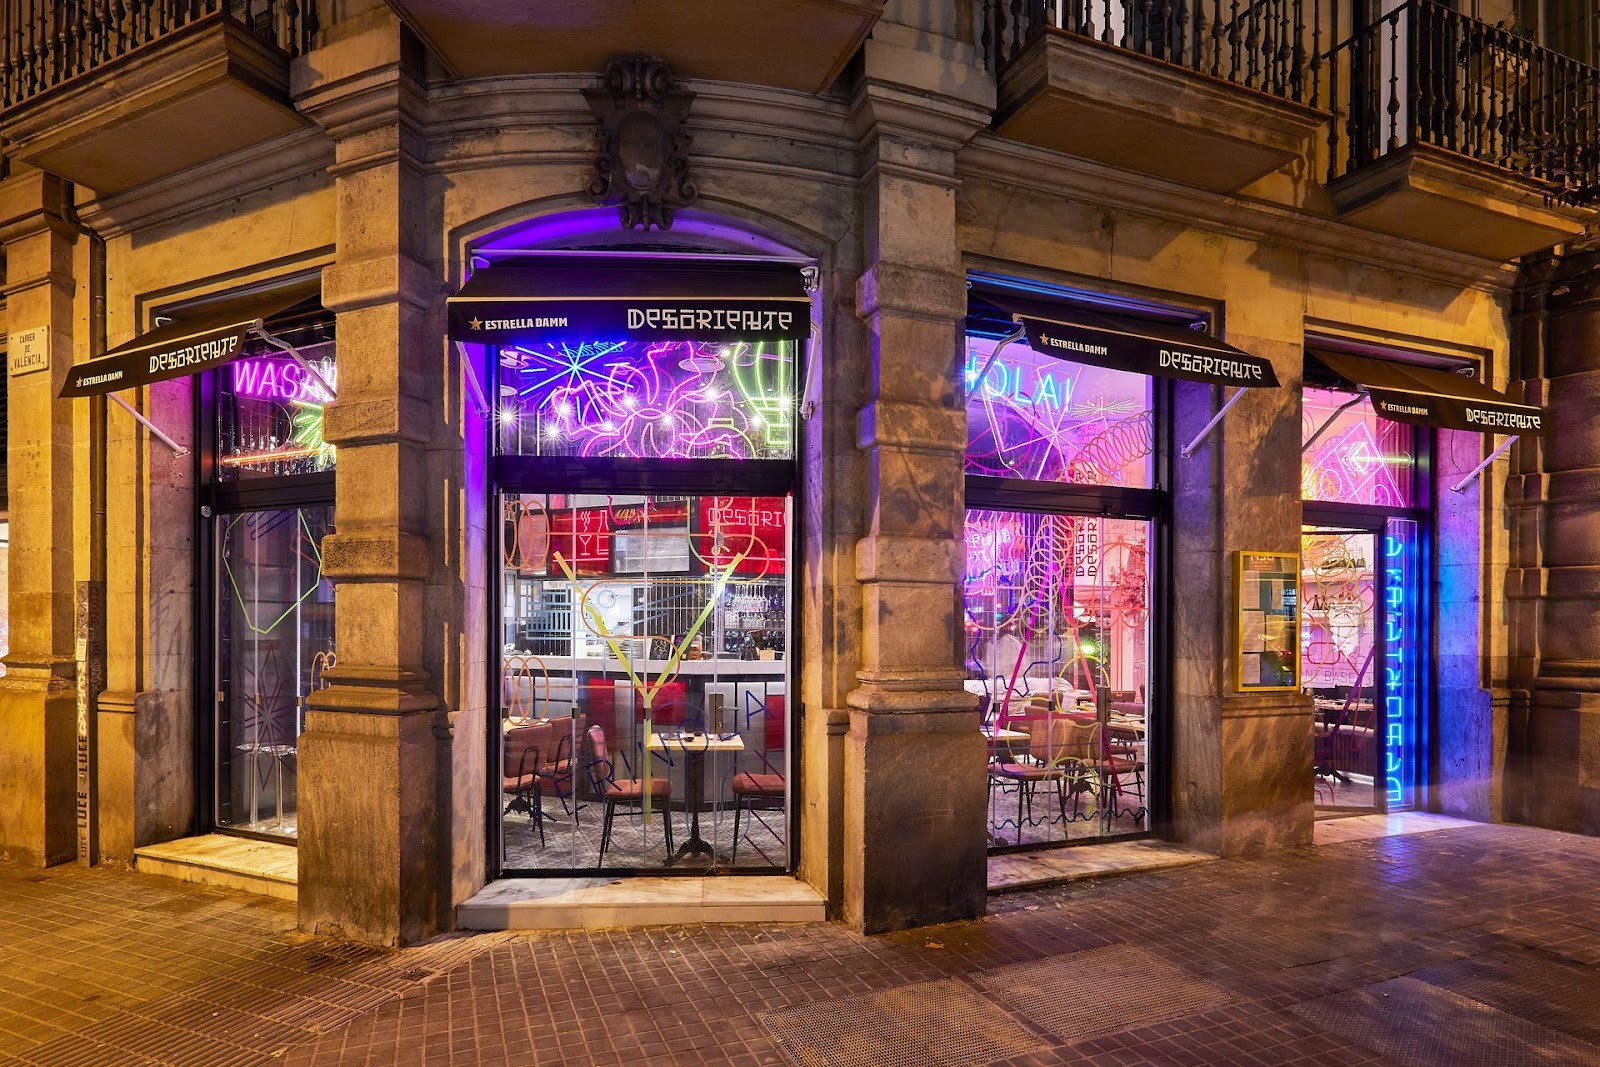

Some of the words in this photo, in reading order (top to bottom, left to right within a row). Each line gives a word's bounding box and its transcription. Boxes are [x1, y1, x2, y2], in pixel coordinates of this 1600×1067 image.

[484, 318, 534, 330] ESTRELLA
[535, 317, 568, 328] DAMM
[19, 332, 36, 344] CARRER
[24, 344, 31, 353] DE
[1050, 337, 1084, 352] ESTRELLA
[1084, 344, 1108, 356] DAMM
[82, 373, 108, 386] ESTRELLA
[107, 370, 123, 382] DAMM
[1387, 403, 1412, 414] ESTRELLA
[1411, 406, 1429, 416] DAMM
